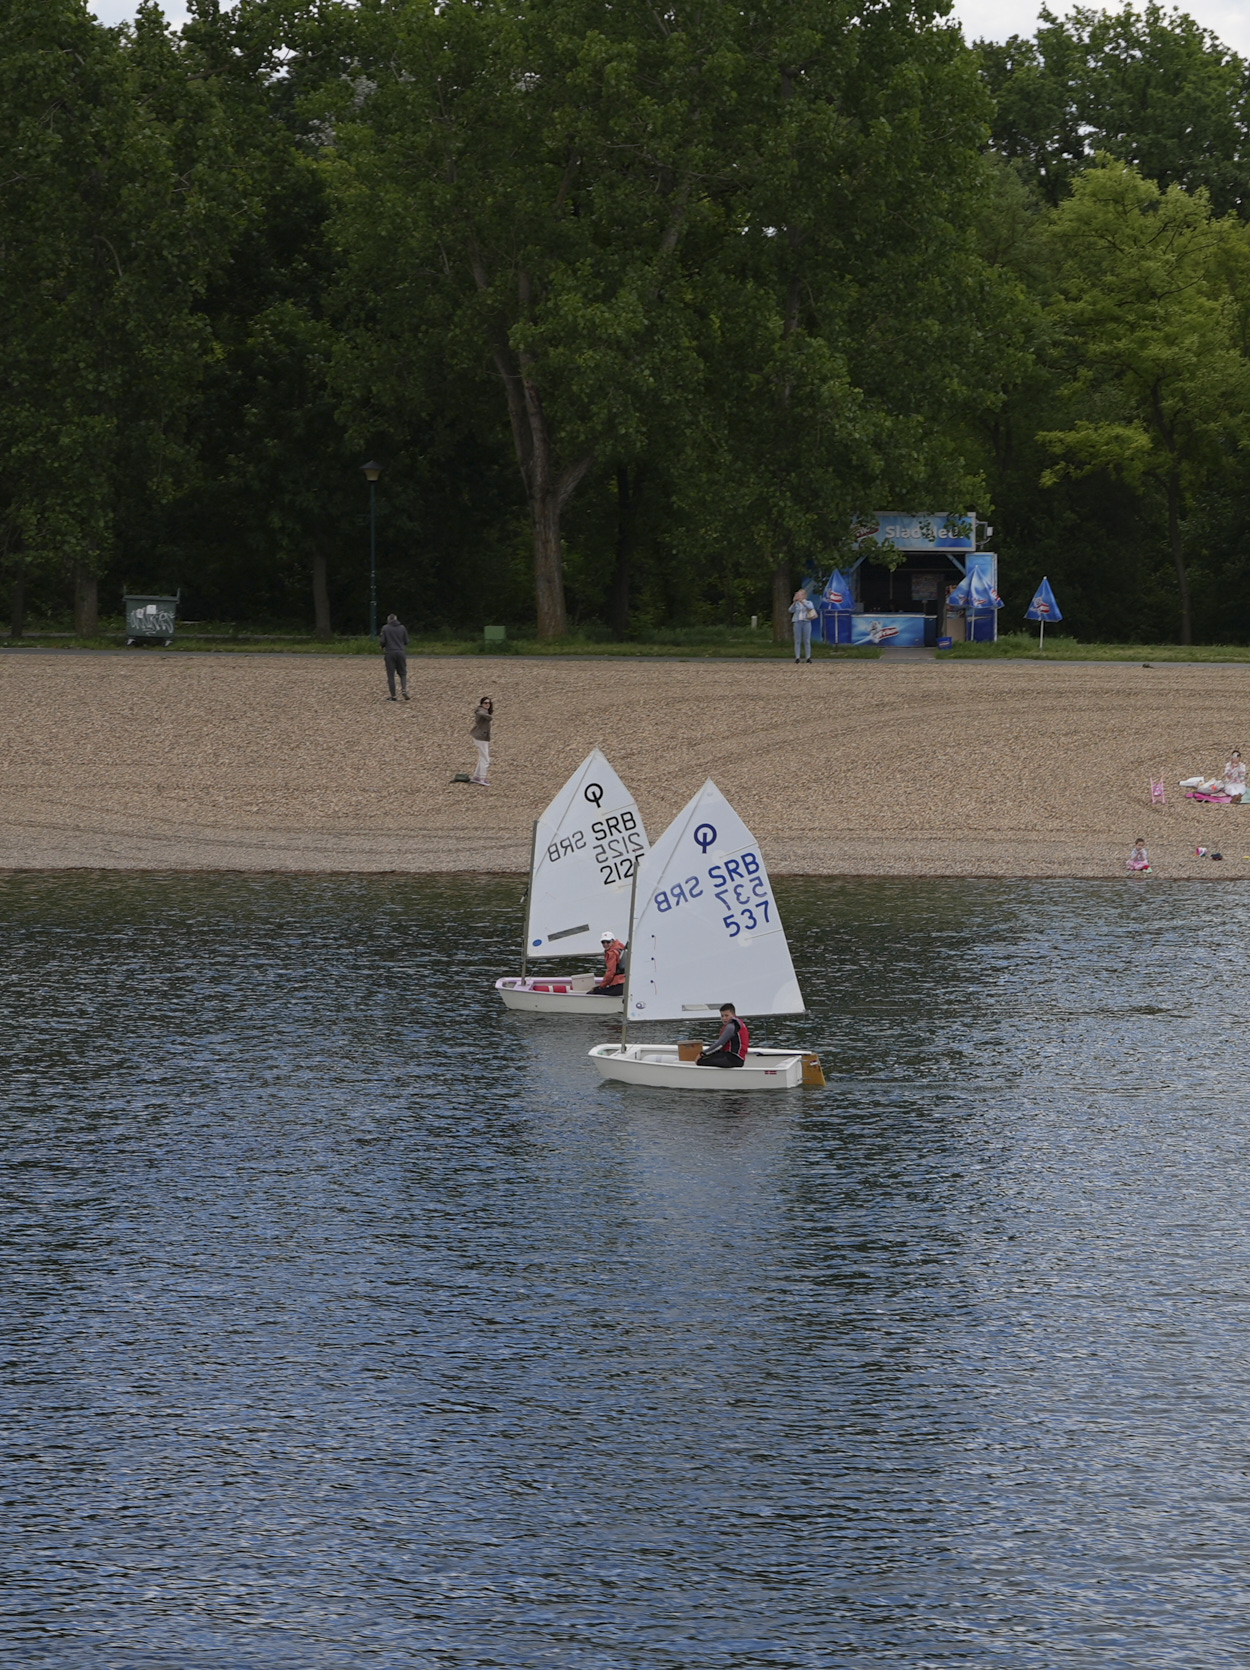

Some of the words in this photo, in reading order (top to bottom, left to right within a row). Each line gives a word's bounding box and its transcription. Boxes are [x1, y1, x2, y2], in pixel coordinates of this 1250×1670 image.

[591, 811, 637, 842] SRB
[708, 852, 760, 889] SRB
[722, 900, 770, 938] 537
